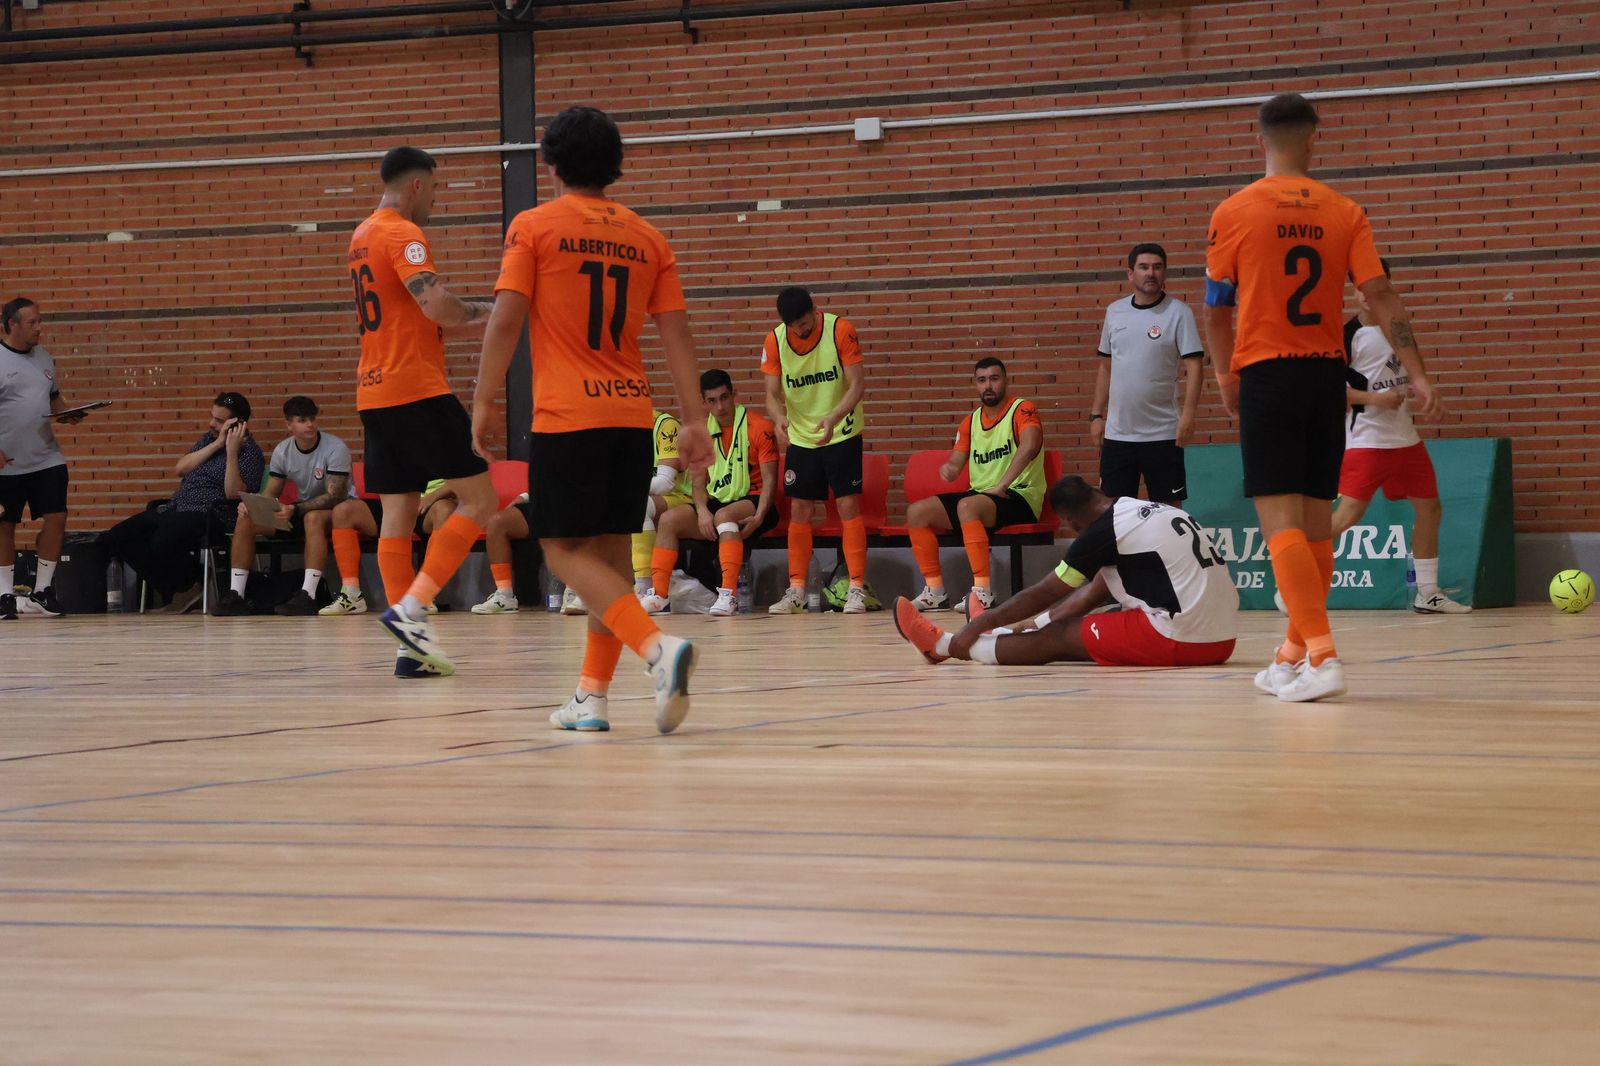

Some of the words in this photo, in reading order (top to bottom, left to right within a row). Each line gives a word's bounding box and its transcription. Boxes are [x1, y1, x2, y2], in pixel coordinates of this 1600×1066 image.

[1277, 224, 1325, 240] DAVID
[559, 238, 648, 264] ALBERTICO.L
[1284, 245, 1323, 327] 2
[578, 260, 630, 352] 11
[583, 379, 652, 398] uvesa
[786, 365, 839, 389] hummel
[973, 438, 1012, 465] hummel
[713, 473, 733, 493] hum
[1236, 571, 1265, 589] DE
[1331, 570, 1374, 588] ORA
